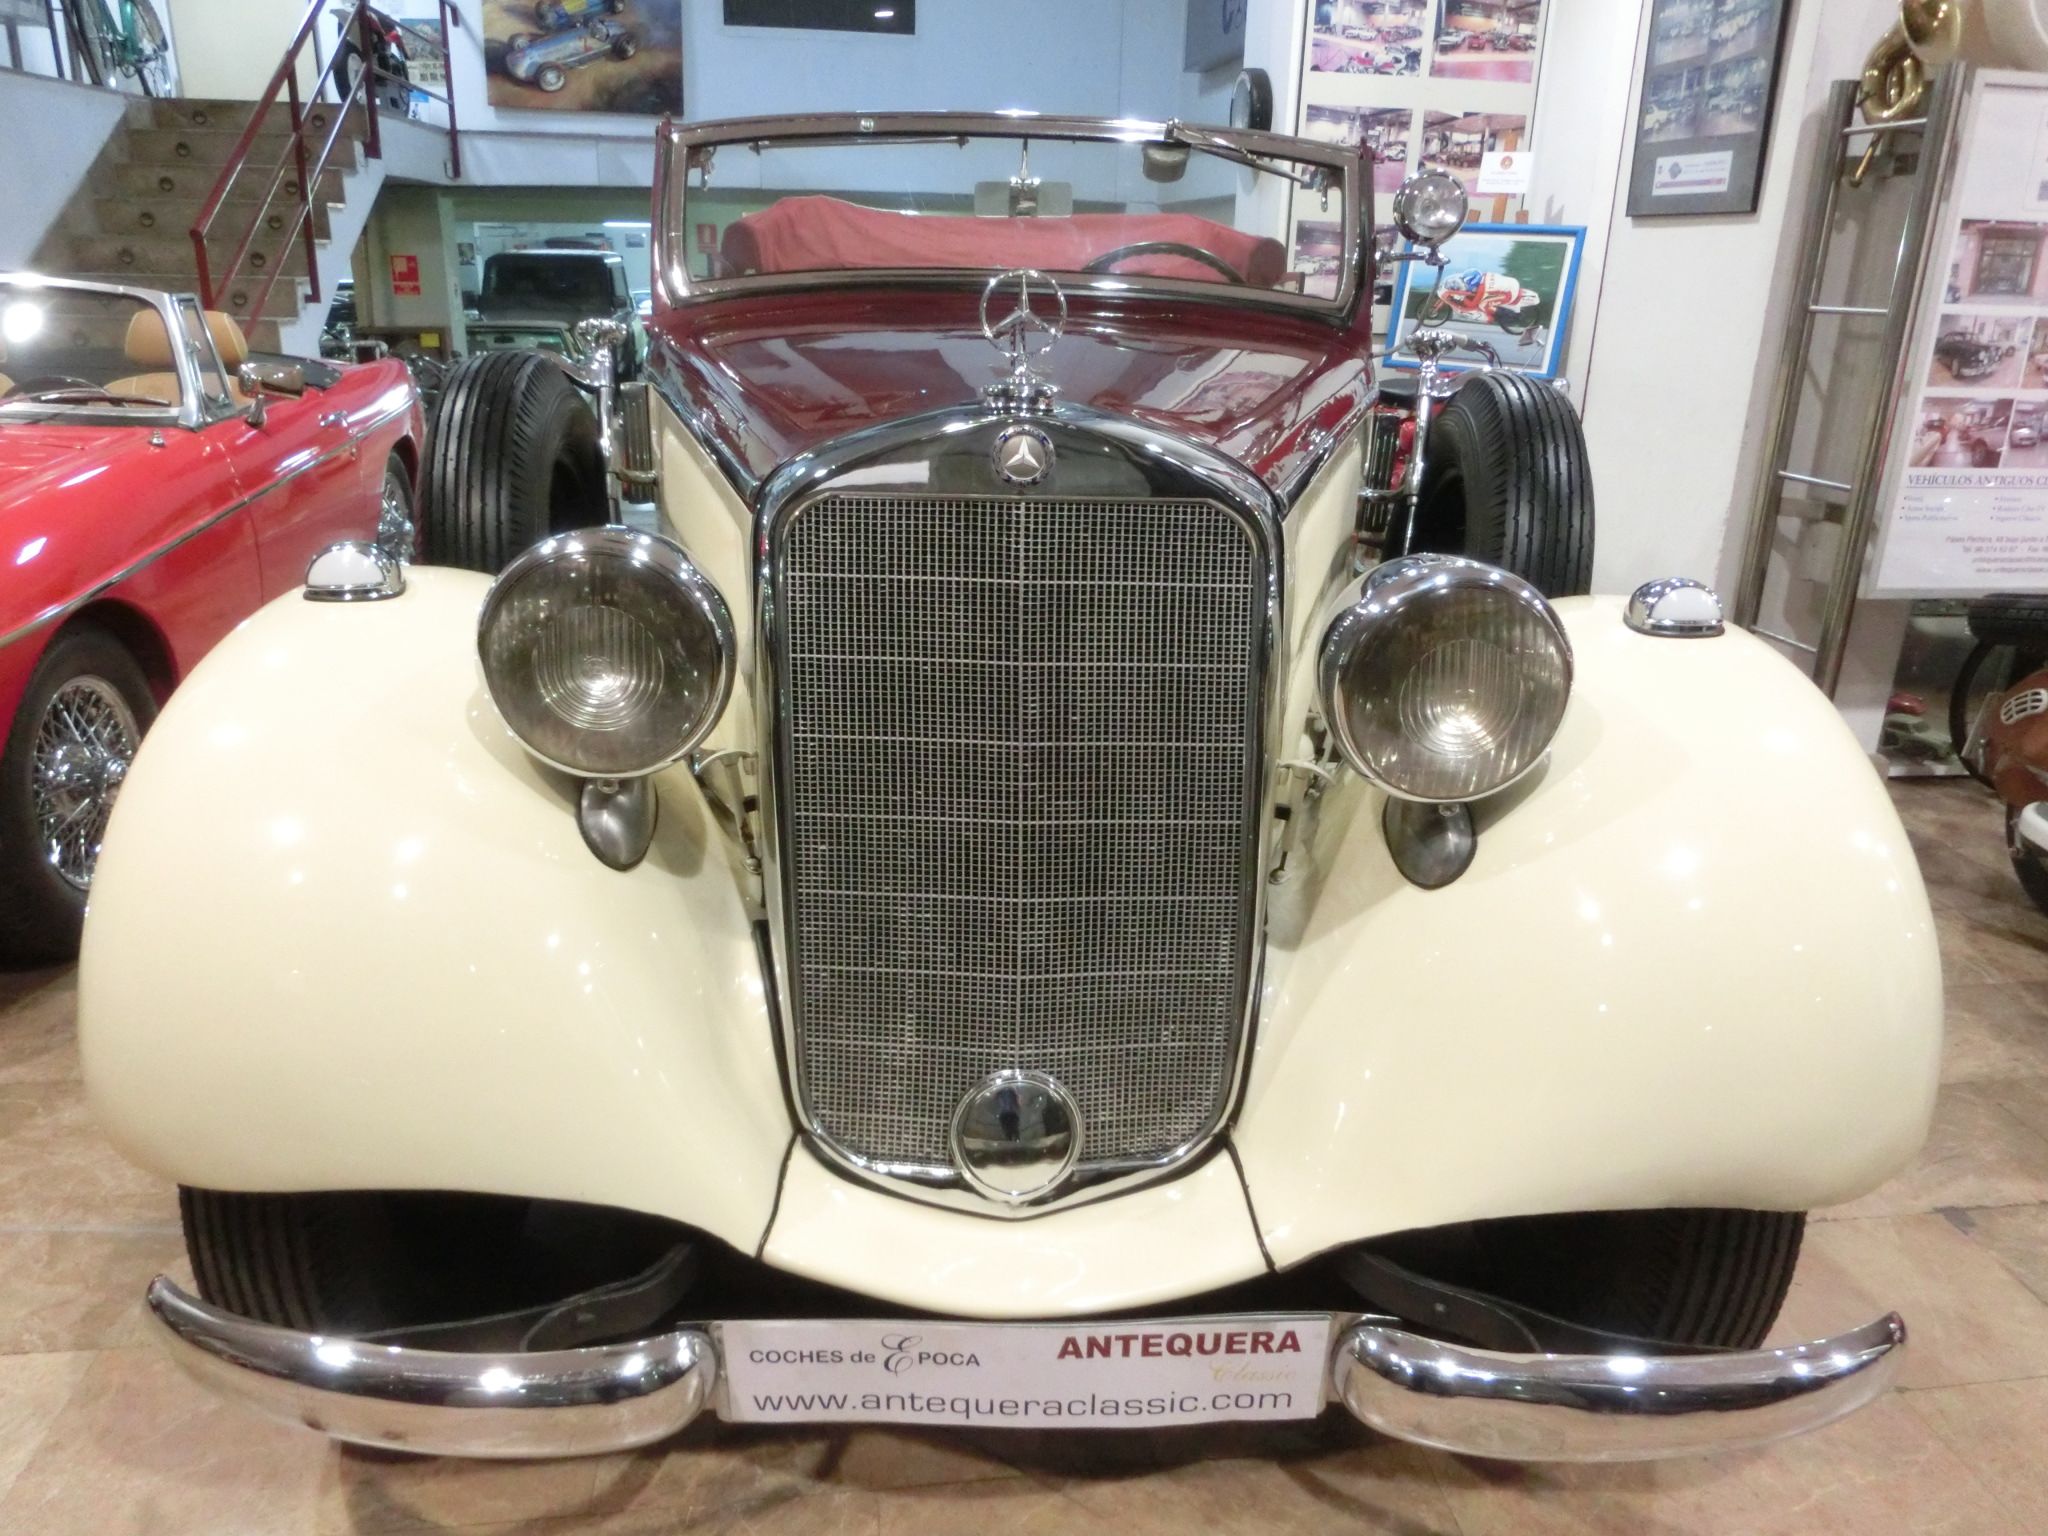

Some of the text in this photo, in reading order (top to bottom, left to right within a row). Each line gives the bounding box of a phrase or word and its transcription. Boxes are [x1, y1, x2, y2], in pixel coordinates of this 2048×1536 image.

[750, 1350, 843, 1364] COCHES
[850, 1350, 876, 1364] de
[1057, 1330, 1302, 1359] ANTEQUERA
[753, 1391, 1292, 1419] www.antequeraclassic.com
